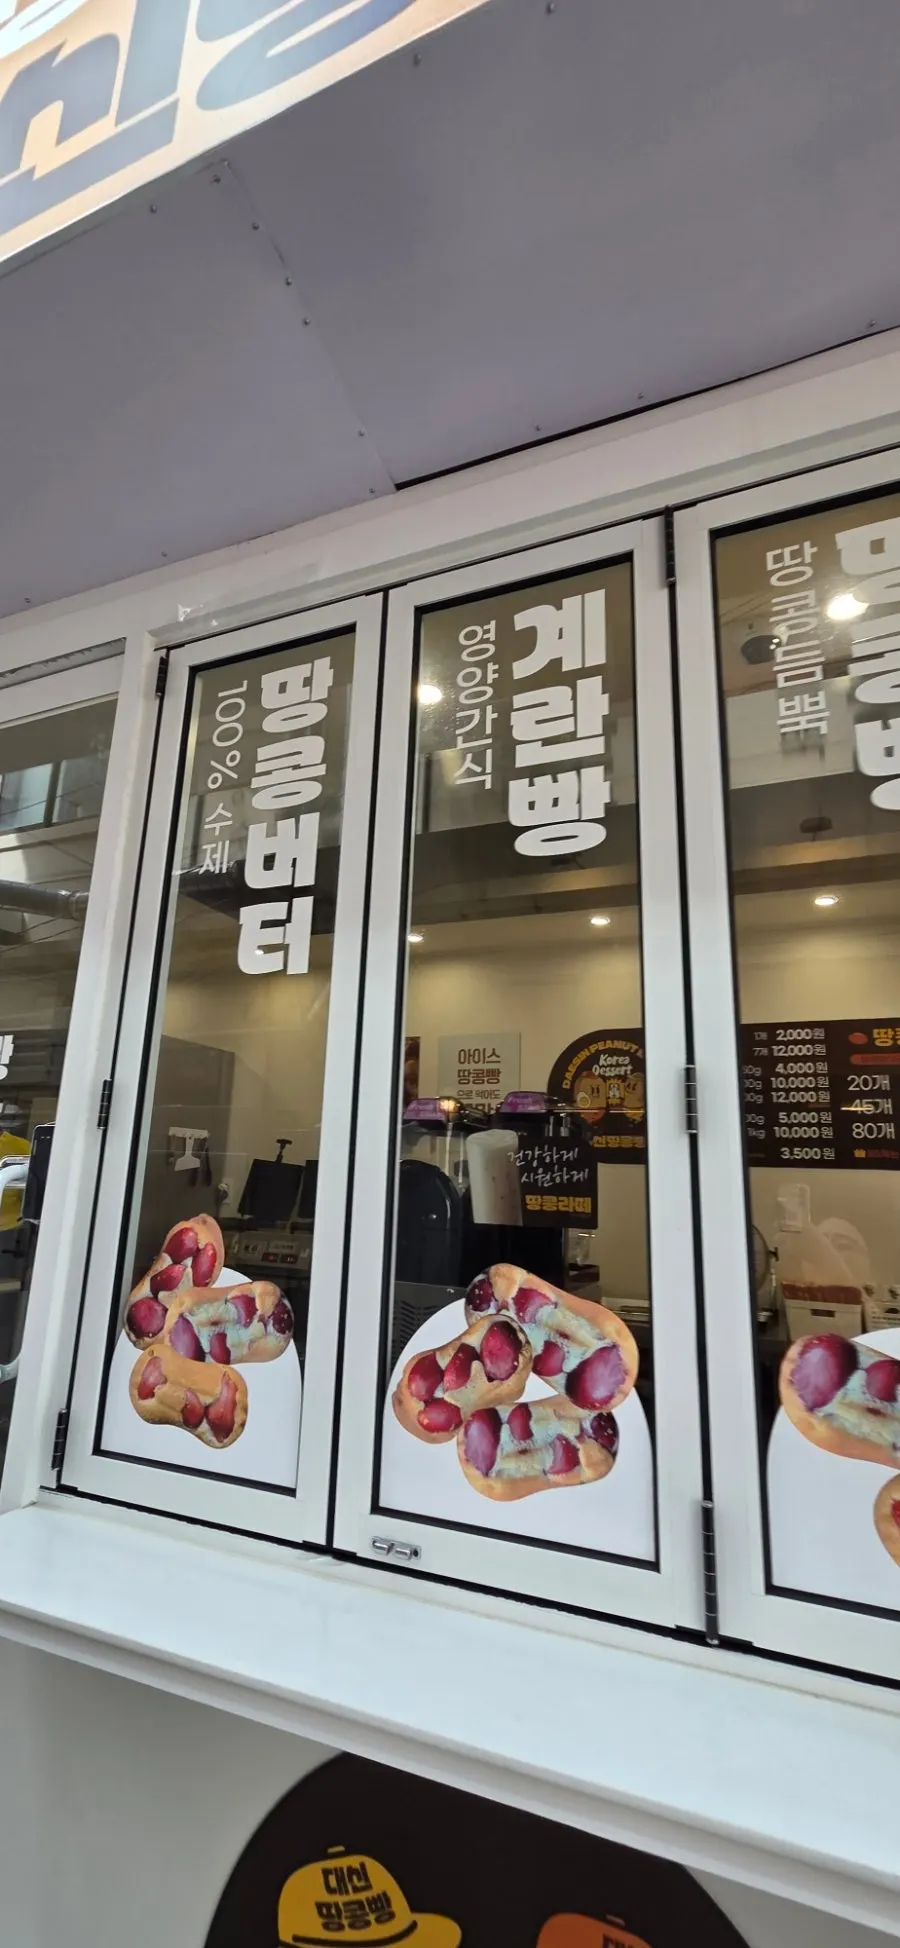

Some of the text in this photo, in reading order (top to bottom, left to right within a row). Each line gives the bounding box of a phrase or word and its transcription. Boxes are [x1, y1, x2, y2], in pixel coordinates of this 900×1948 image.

[766, 540, 831, 736] 땅콩듬뿍
[455, 619, 498, 790] 영양간식
[508, 589, 612, 858] 계란빵
[199, 680, 248, 875] 100% 수제
[237, 656, 334, 975] 땅콩버터
[776, 1028, 825, 1041] 2,000원
[589, 1040, 640, 1054] PEANUT
[771, 1044, 827, 1057] 12,000원
[457, 1048, 501, 1064] 아이스
[457, 1068, 501, 1085] 땅콩빵
[775, 1062, 828, 1075] 4,000원
[770, 1076, 830, 1088] 10,000원
[847, 1075, 891, 1091] 20개
[771, 1091, 831, 1103] 12,000원
[778, 1111, 833, 1123] 5,000원
[774, 1126, 834, 1139] 10,000원
[852, 1122, 895, 1139] 80개
[506, 1145, 579, 1167] 건강하게
[780, 1147, 836, 1160] 3,500원
[520, 1167, 589, 1188] 시원하게
[524, 1195, 592, 1214] 땅콩라떼
[321, 1862, 373, 1896] 대신
[315, 1890, 396, 1932] 땅콩빵
